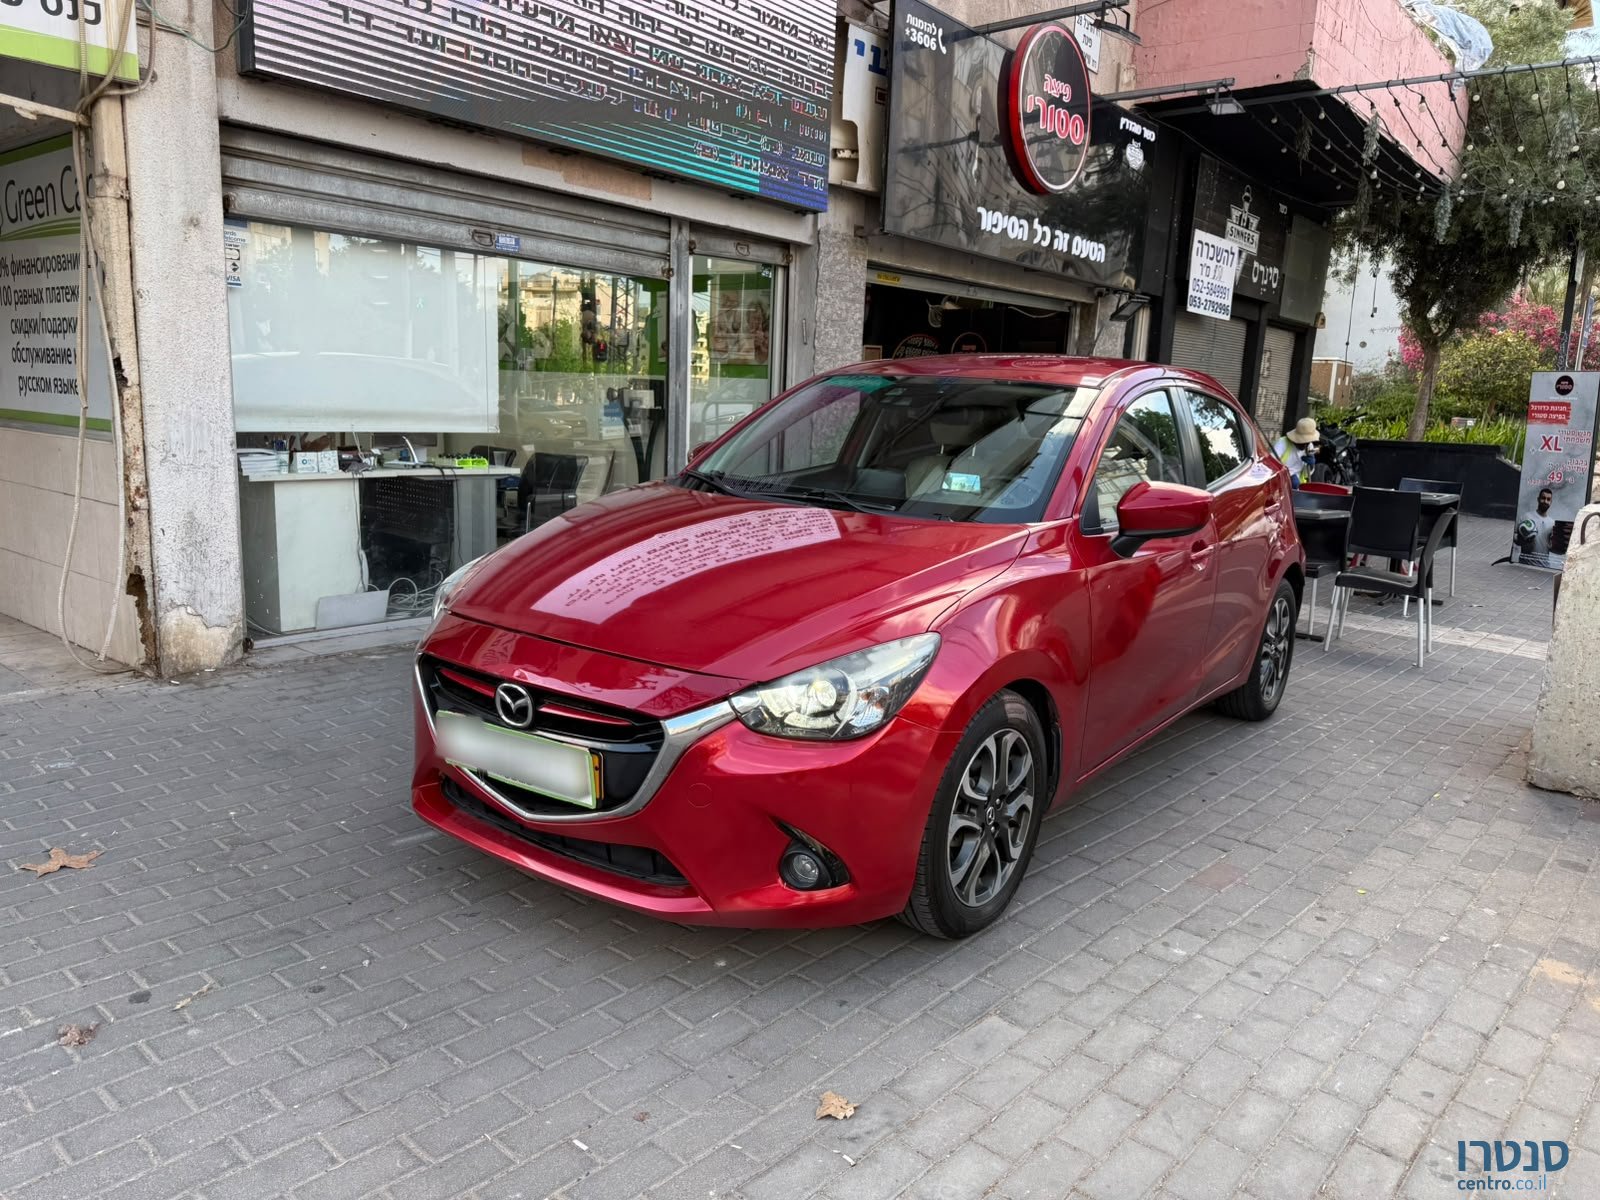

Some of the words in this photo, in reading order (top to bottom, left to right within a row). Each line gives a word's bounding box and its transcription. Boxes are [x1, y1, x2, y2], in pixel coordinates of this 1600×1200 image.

[905, 13, 937, 36] להזמנות
[1043, 73, 1072, 103] פיצה
[1026, 94, 1085, 146] סטורי
[5, 180, 56, 223] Green
[976, 206, 1029, 242] הסיפור
[1032, 217, 1052, 247] כל
[1228, 226, 1256, 246] SINNERS
[1053, 229, 1070, 253] זה
[1195, 240, 1236, 268] להשכרה
[226, 274, 241, 282] VISA
[13, 285, 44, 310] равных
[11, 341, 72, 368] обслуживание
[18, 374, 52, 397] русском
[1540, 435, 1563, 452] XL
[1548, 471, 1563, 483] 49
